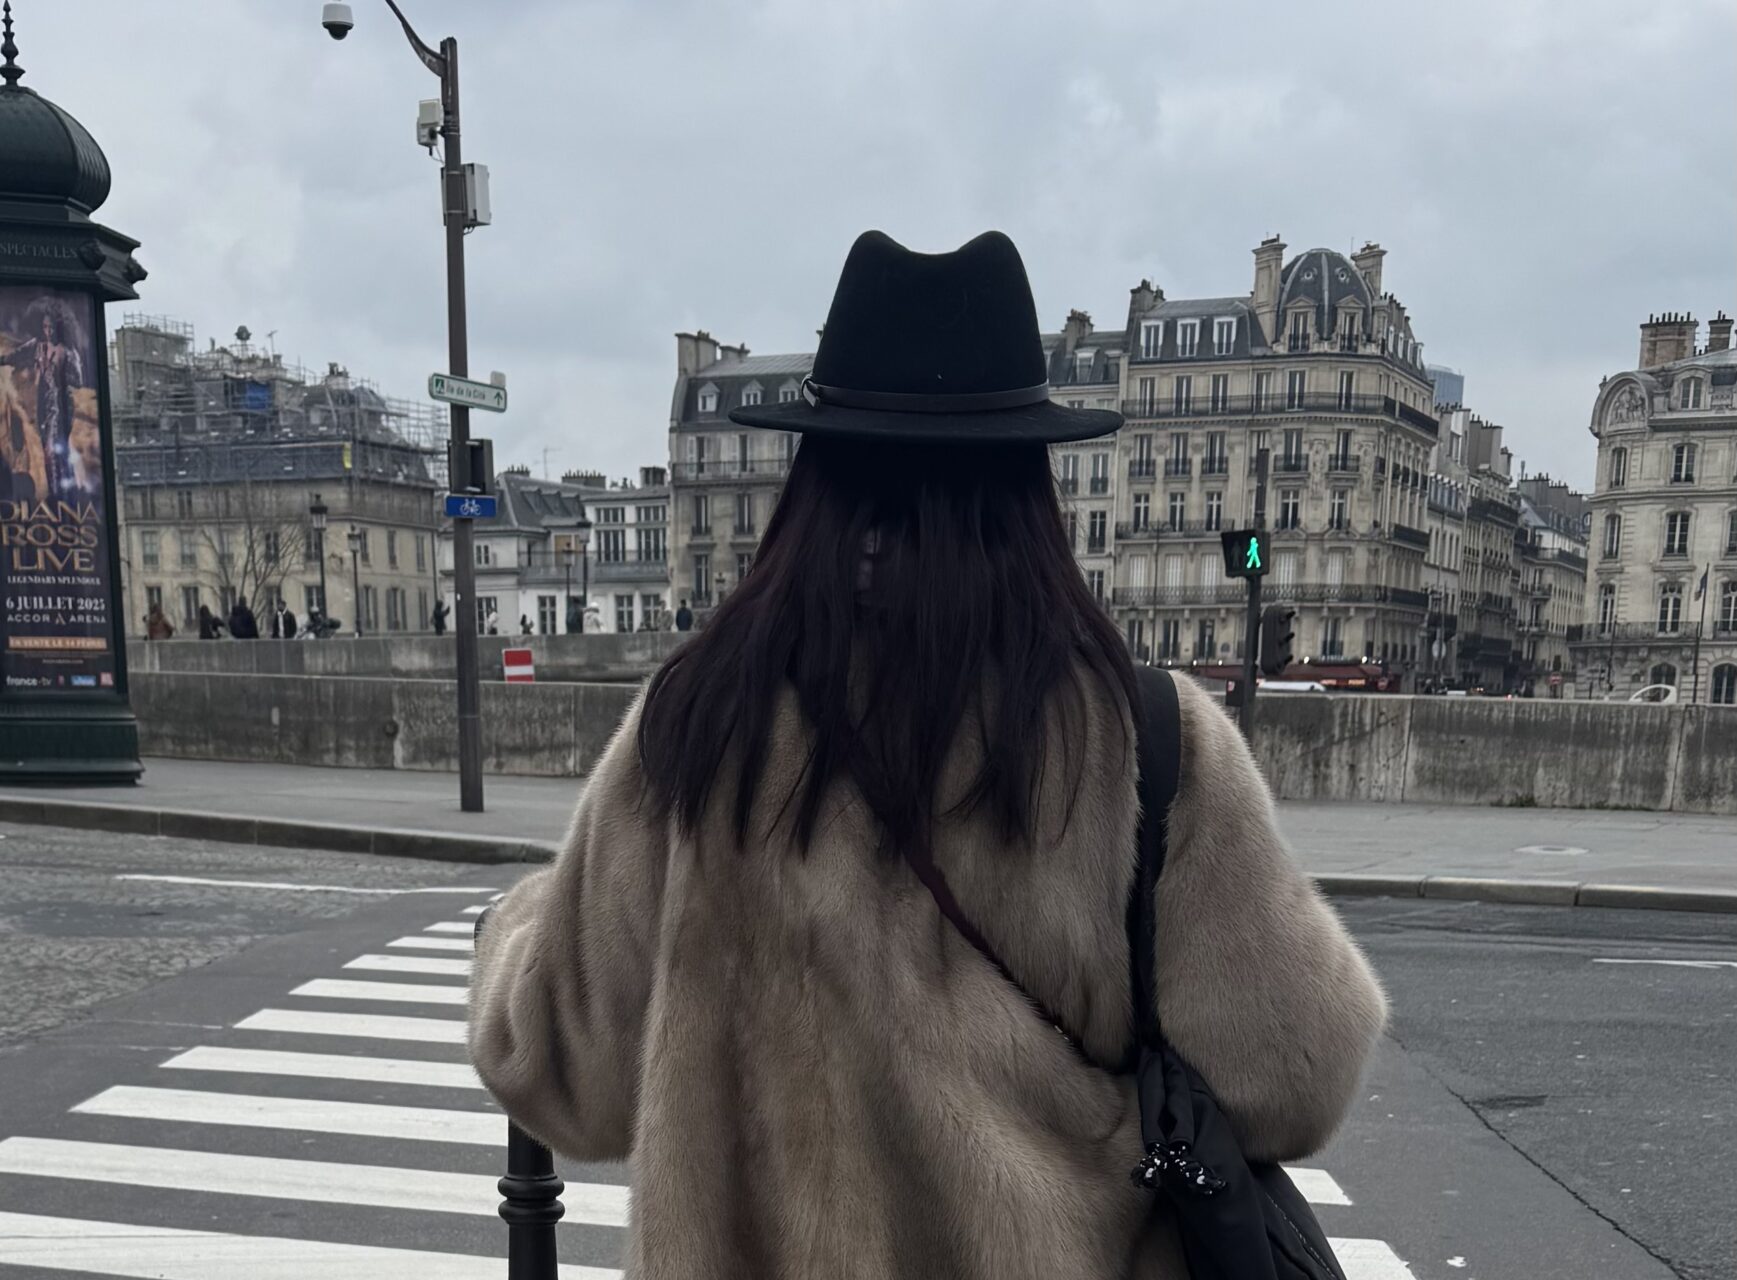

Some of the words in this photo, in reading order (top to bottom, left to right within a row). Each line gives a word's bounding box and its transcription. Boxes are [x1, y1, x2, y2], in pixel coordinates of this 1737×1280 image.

[0, 243, 78, 258] SPECTACLES
[0, 500, 101, 524] DIANA
[2, 523, 98, 547] ROSS
[13, 548, 95, 571] LIVE
[6, 597, 15, 609] 6
[17, 596, 74, 610] JUILLET
[77, 598, 105, 611] 2025
[7, 613, 50, 622] ACCOR
[69, 614, 106, 623] ARENA
